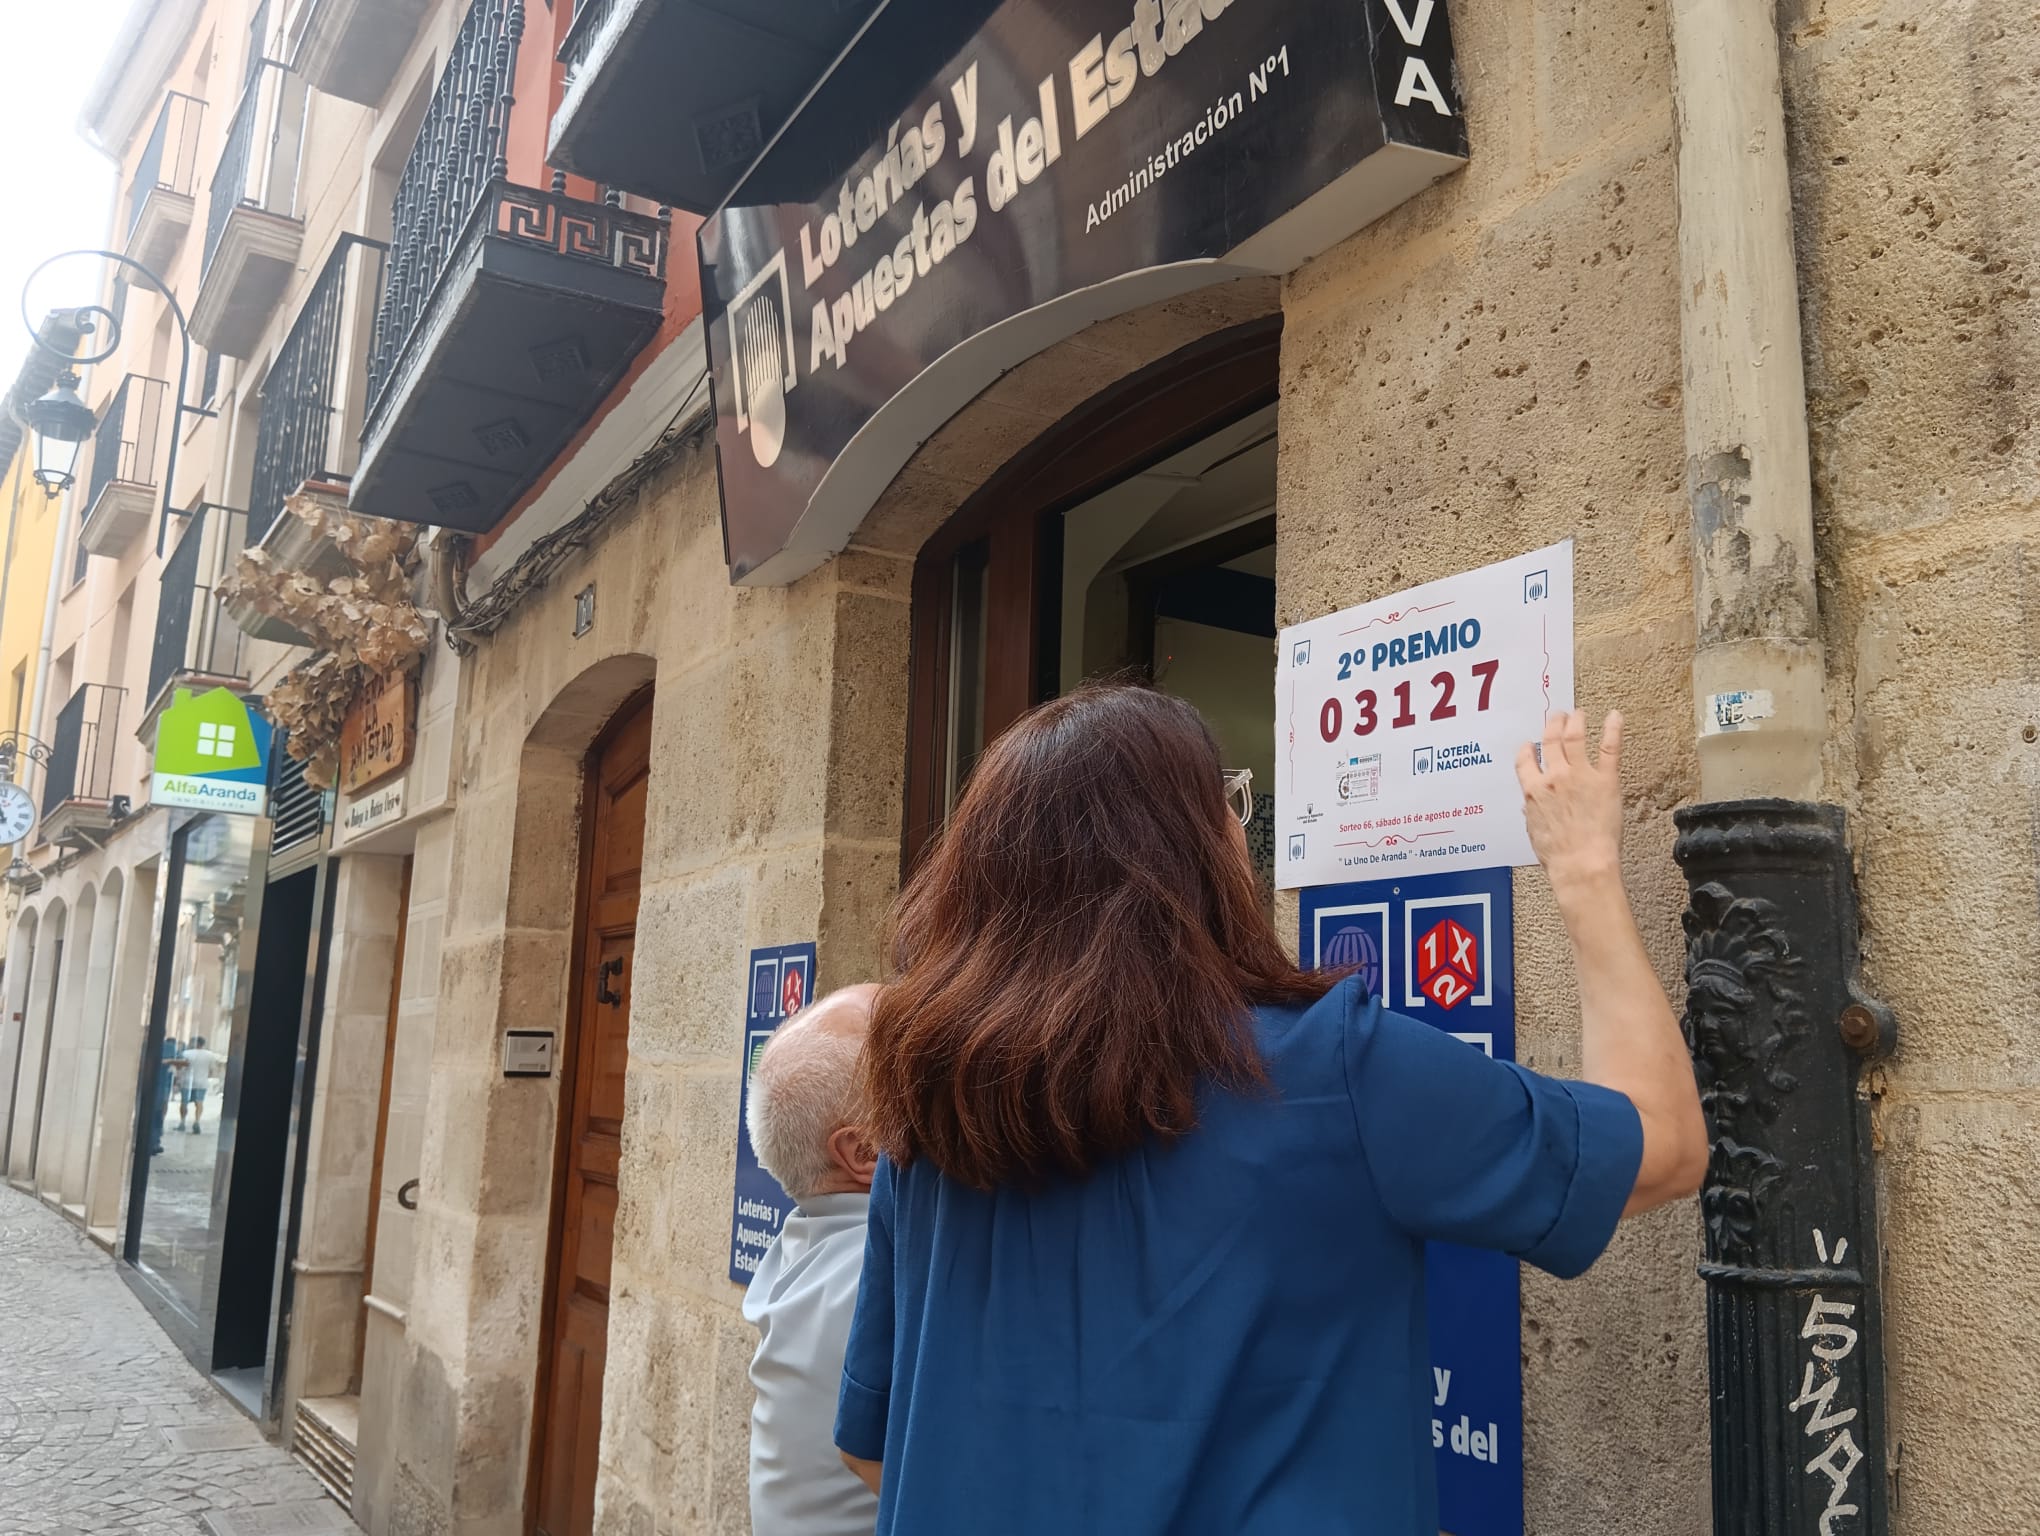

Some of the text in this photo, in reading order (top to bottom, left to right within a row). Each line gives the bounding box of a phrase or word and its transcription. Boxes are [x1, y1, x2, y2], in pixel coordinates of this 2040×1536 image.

[800, 60, 978, 290] Loterías y
[1085, 93, 1244, 235] Administración
[810, 0, 1235, 375] Apuestas del Esta
[1337, 618, 1481, 681] 2º PREMIO
[363, 703, 378, 735] LA
[350, 722, 394, 773] AMISTAD
[1437, 741, 1481, 759] LOTERÍA
[1437, 753, 1493, 771] NACIONAL
[164, 779, 257, 801] AlfaAranda
[1340, 823, 1362, 833] Sorteo
[1376, 816, 1401, 828] sábado
[1403, 814, 1412, 824] 16
[1413, 813, 1423, 823] de
[1425, 809, 1450, 823] agosto
[1452, 807, 1462, 817] de
[1464, 804, 1484, 816] 2025
[1344, 857, 1352, 866] La
[1353, 855, 1369, 865] Uno
[1370, 854, 1380, 864] De
[1381, 850, 1407, 862] Aranda
[1420, 846, 1447, 858] Aranda
[1448, 845, 1460, 855] De
[1461, 843, 1486, 854] Duero
[738, 1195, 780, 1229] Loterías y
[1433, 1366, 1451, 1406] y
[1450, 1414, 1498, 1464] del
